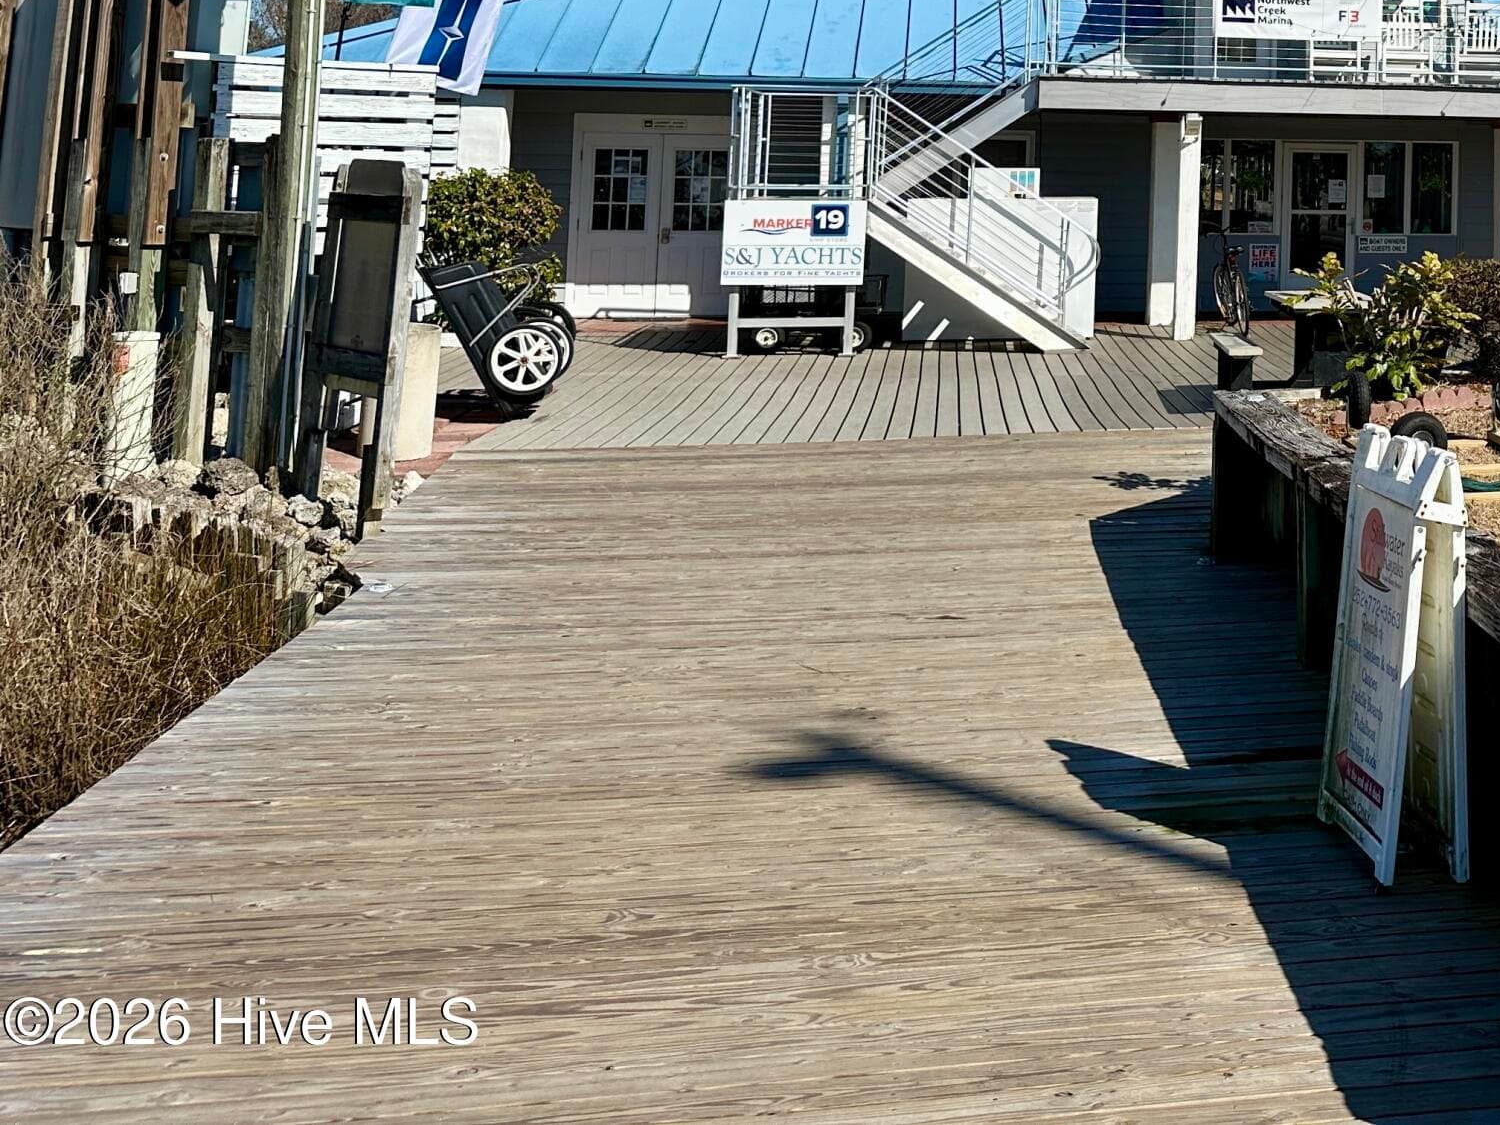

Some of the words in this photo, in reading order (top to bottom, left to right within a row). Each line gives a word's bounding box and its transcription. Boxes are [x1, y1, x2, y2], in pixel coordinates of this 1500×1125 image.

[1257, 5, 1286, 15] Creek
[1257, 15, 1292, 25] Marina
[753, 218, 813, 228] MARKER
[815, 210, 845, 230] 19
[724, 247, 762, 268] S&J
[770, 247, 862, 266] YACHTS
[1252, 249, 1276, 257] LIFE
[1251, 260, 1276, 268] HERE
